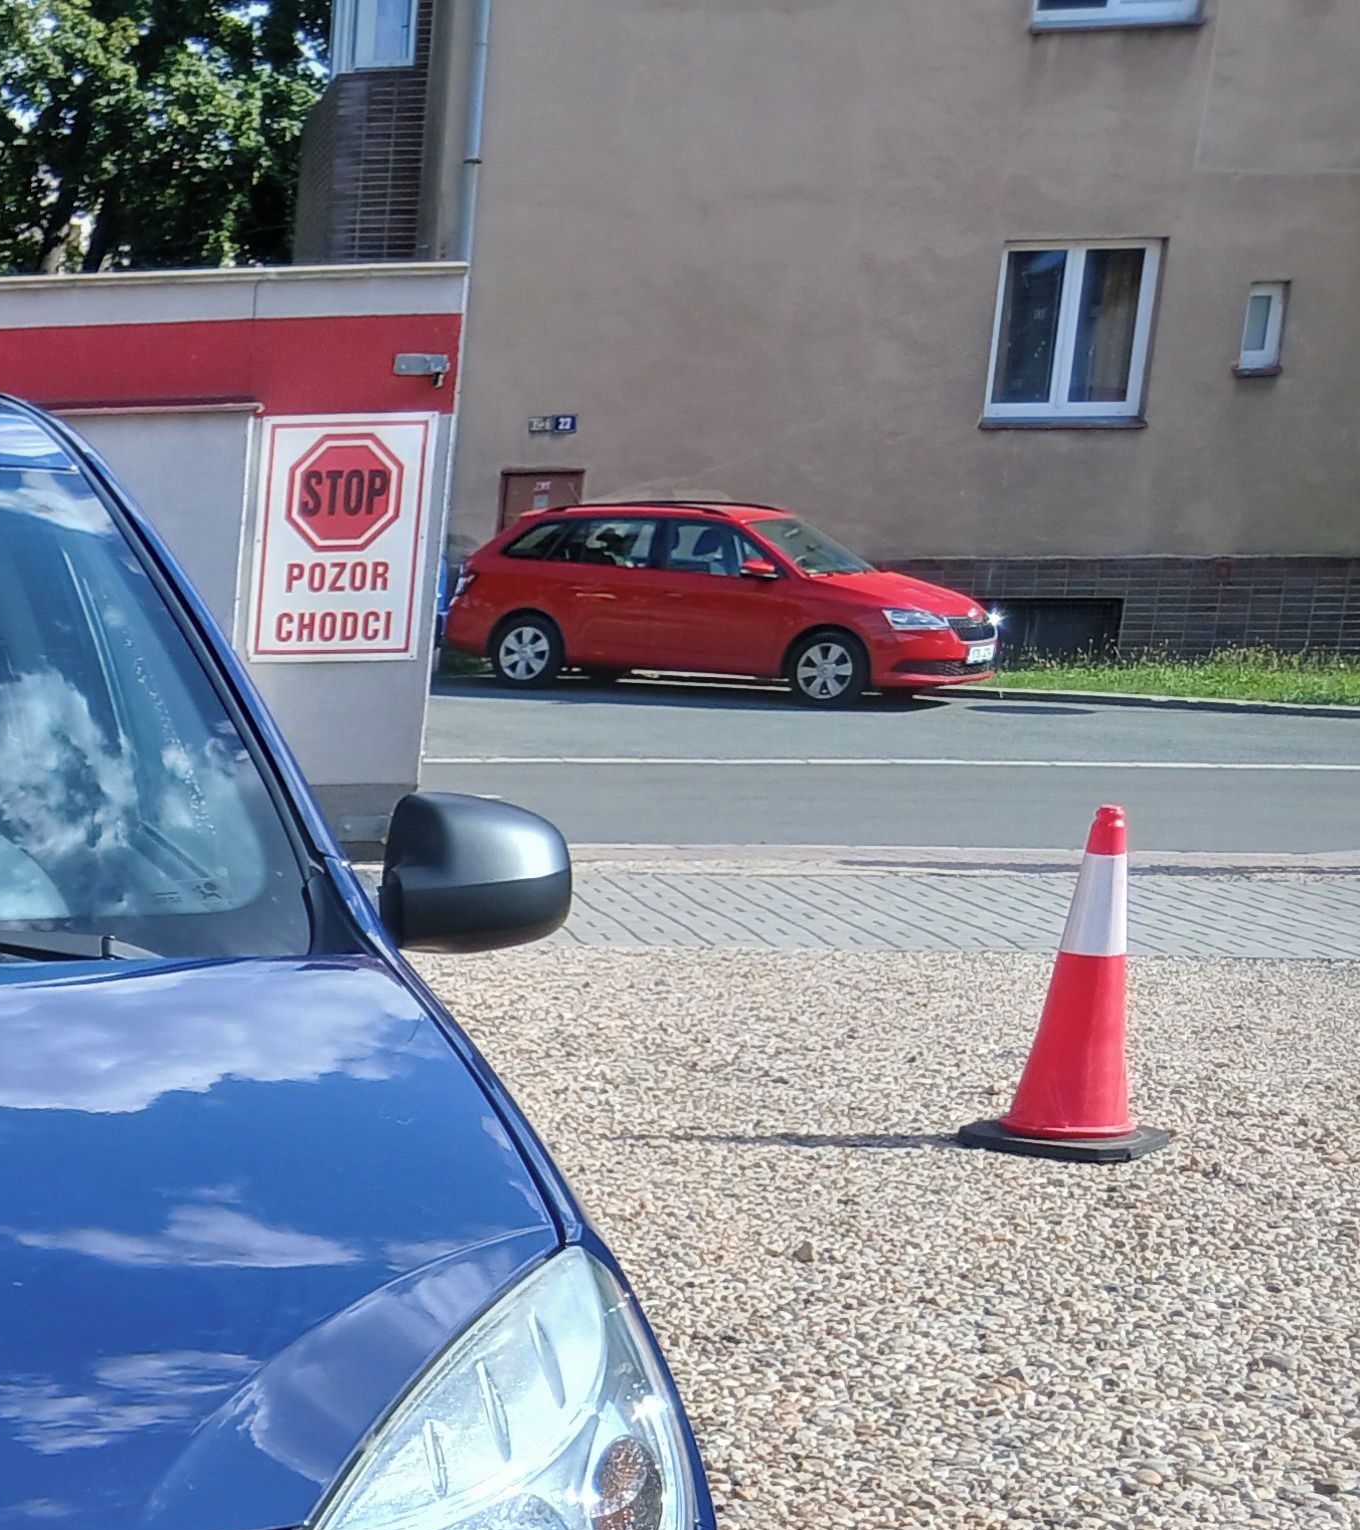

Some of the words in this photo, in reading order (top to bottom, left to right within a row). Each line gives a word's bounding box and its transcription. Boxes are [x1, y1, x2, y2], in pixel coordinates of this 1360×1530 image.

[301, 469, 388, 517] STOP
[285, 561, 389, 593] POZOR
[275, 611, 393, 642] CHODCI
